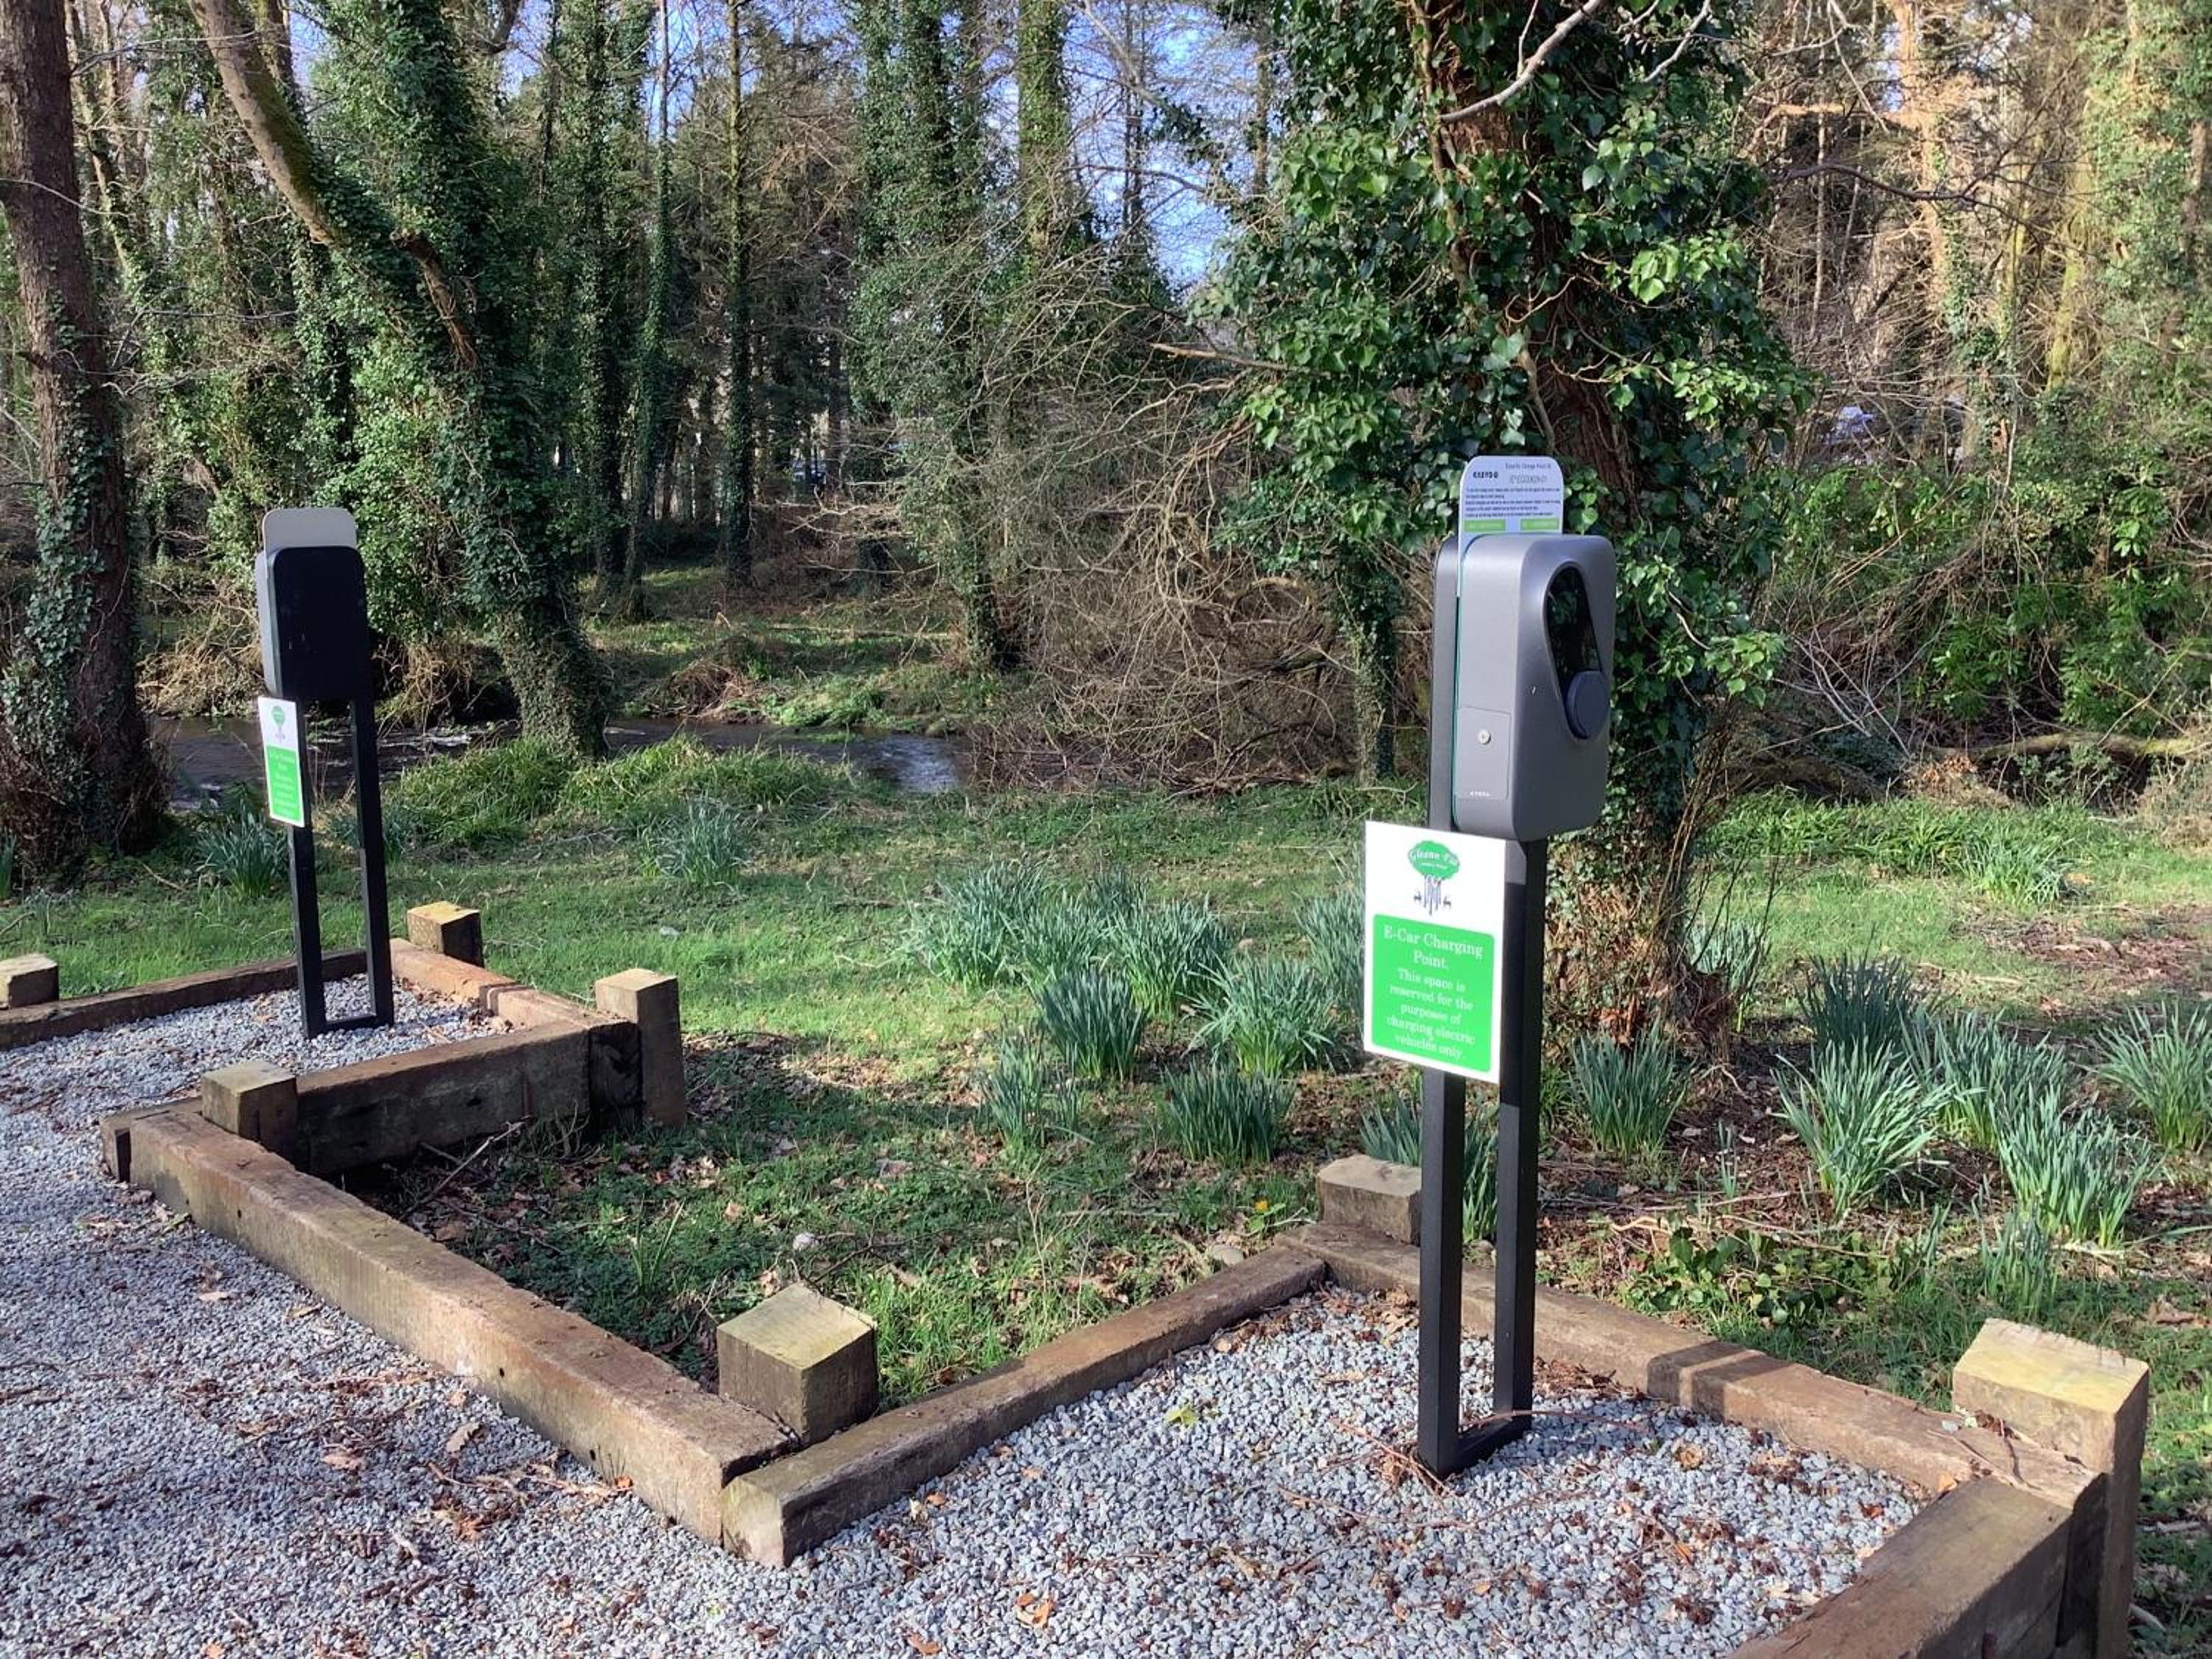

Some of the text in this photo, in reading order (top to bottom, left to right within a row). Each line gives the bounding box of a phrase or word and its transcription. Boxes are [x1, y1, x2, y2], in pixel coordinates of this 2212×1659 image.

[1384, 925, 1484, 960] E-Car Charging
[1398, 967, 1465, 992] This space is
[1389, 985, 1474, 1011] reserved for the
[1386, 1015, 1475, 1044] charging electric
[1450, 1013, 1462, 1024] of
[1394, 1034, 1437, 1051] vehicles
